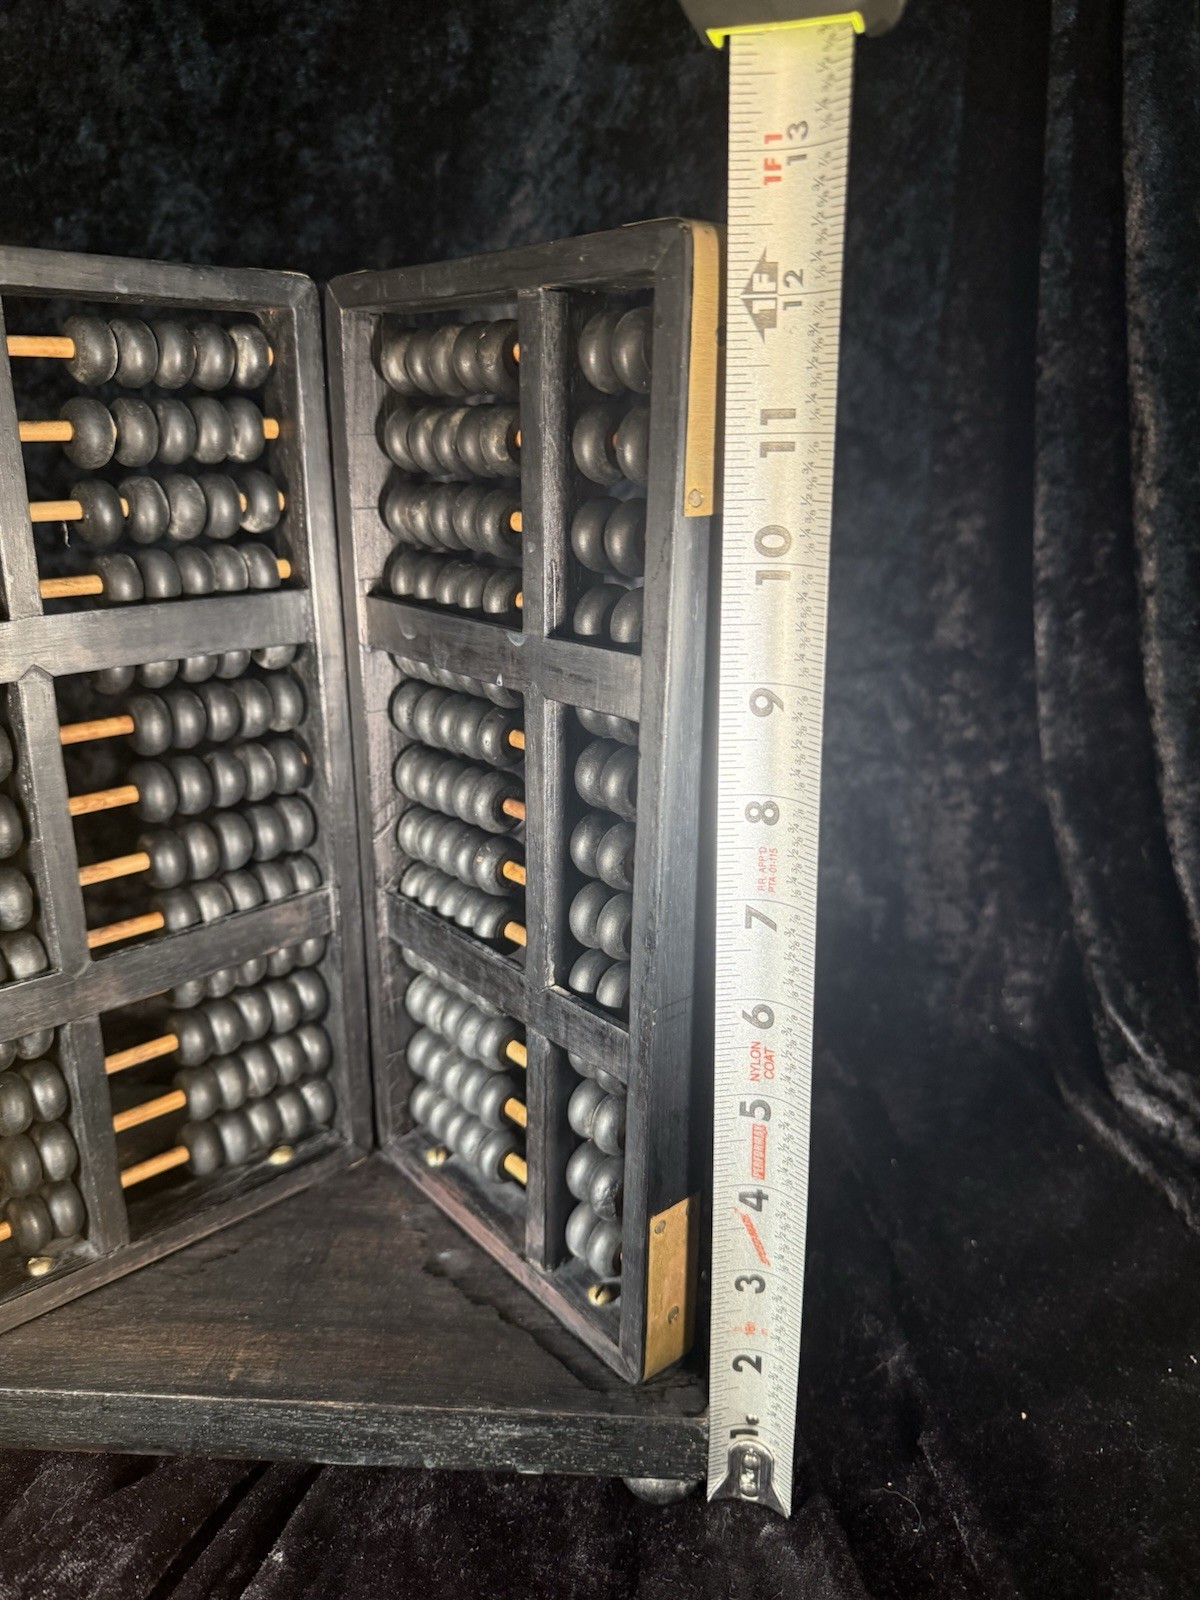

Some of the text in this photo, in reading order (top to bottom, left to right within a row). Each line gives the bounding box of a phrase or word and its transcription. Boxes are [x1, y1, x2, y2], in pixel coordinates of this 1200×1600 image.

[786, 121, 808, 166] 13
[783, 269, 803, 310] 12
[760, 408, 796, 458] 11
[754, 525, 792, 586] 10
[749, 688, 784, 717] 9
[745, 801, 779, 826] 8
[745, 905, 777, 932] 7
[742, 1004, 774, 1029] 6
[750, 1041, 760, 1081] NYLON
[765, 1047, 774, 1079] COAT
[739, 1100, 771, 1122] 5
[739, 1189, 768, 1212] 4
[734, 1274, 765, 1293] 3
[732, 1354, 761, 1374] 2
[730, 1429, 758, 1439] 1
